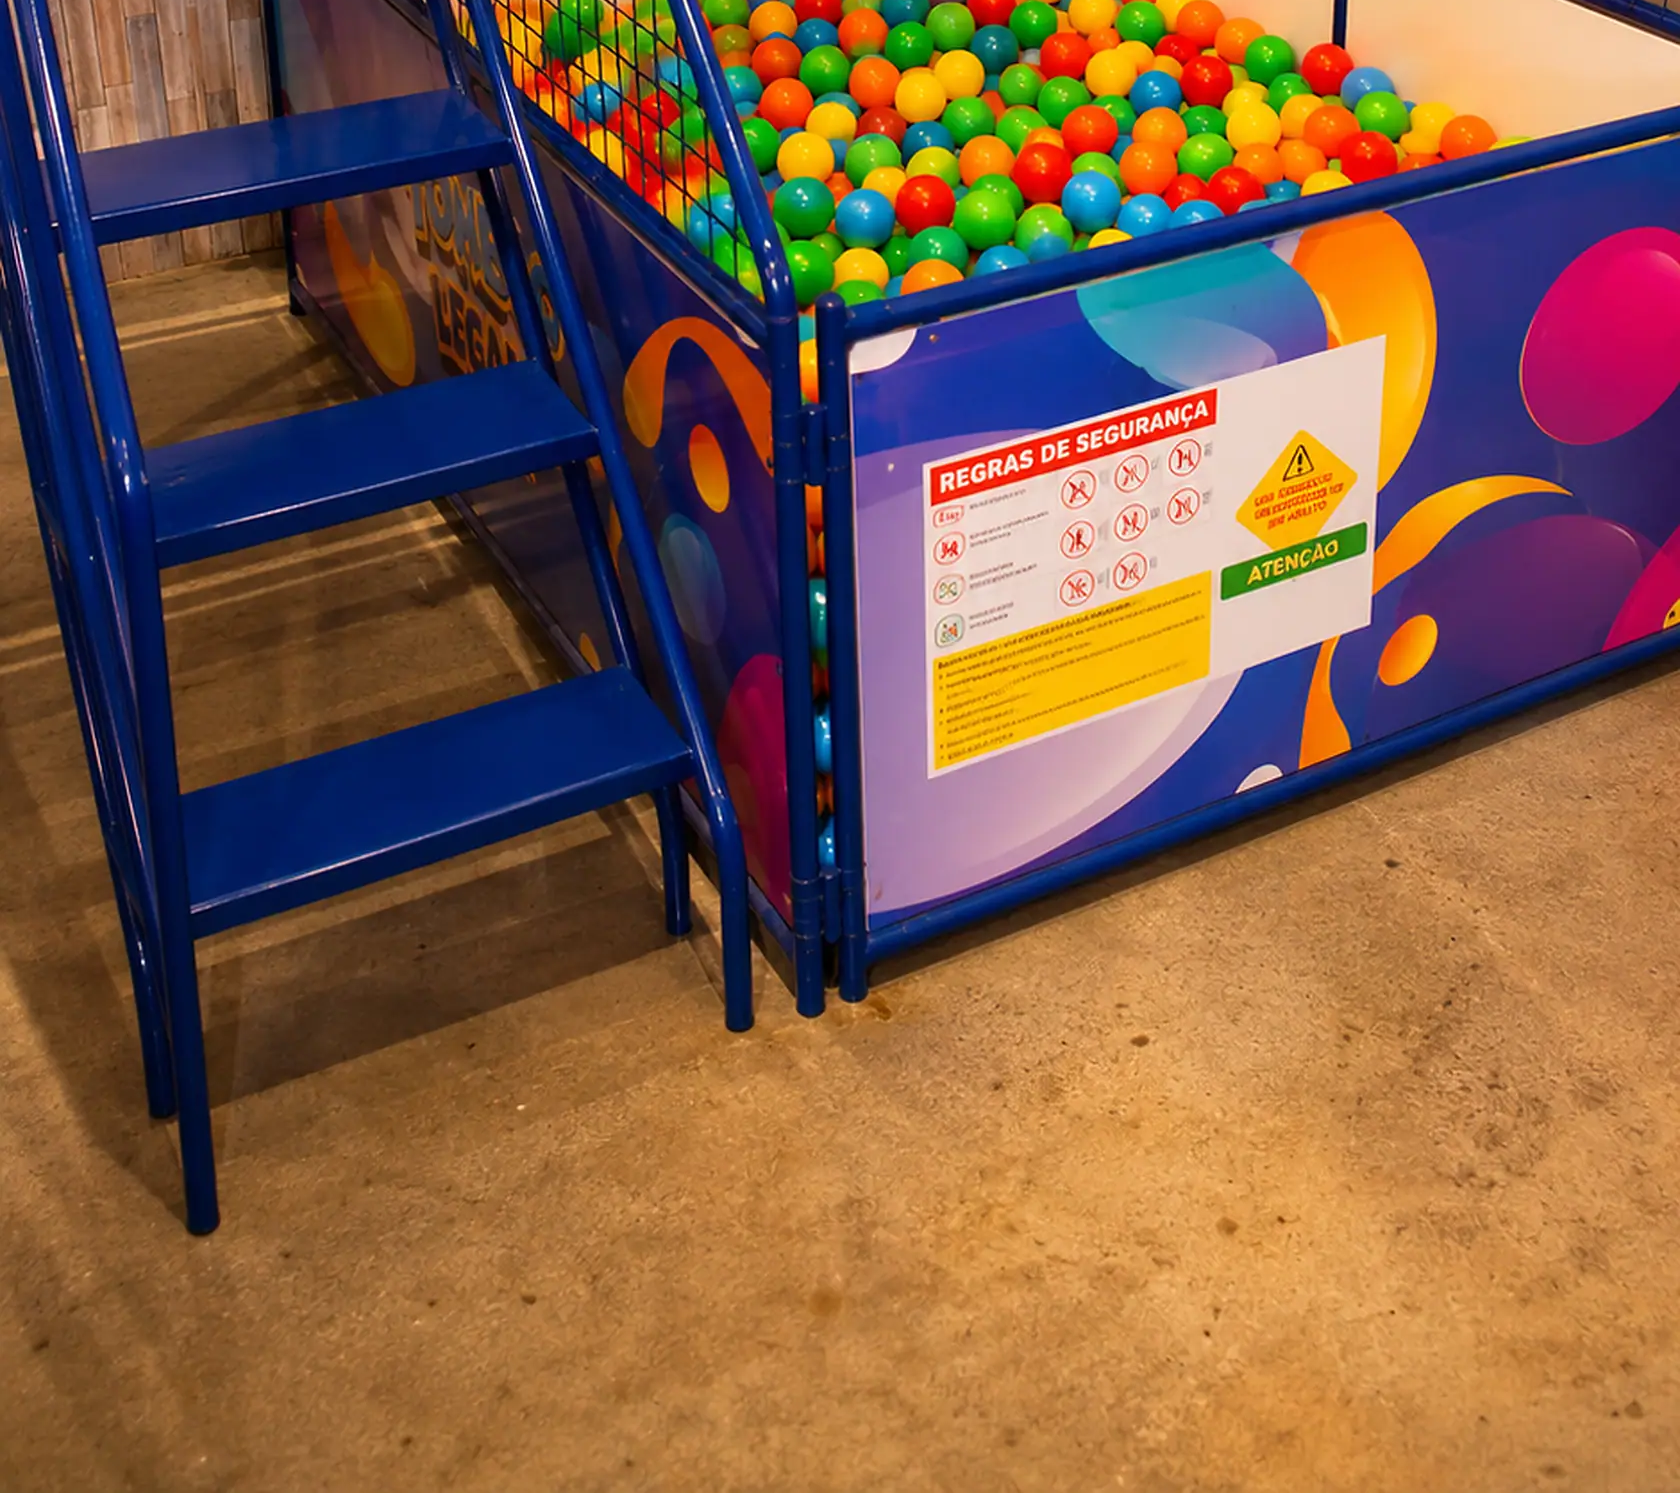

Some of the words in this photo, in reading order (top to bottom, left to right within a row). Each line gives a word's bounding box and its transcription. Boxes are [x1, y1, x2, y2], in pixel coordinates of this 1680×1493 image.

[939, 449, 1033, 494] REGRAS
[1041, 438, 1070, 464] DE
[1076, 399, 1209, 454] SEGURANÇA
